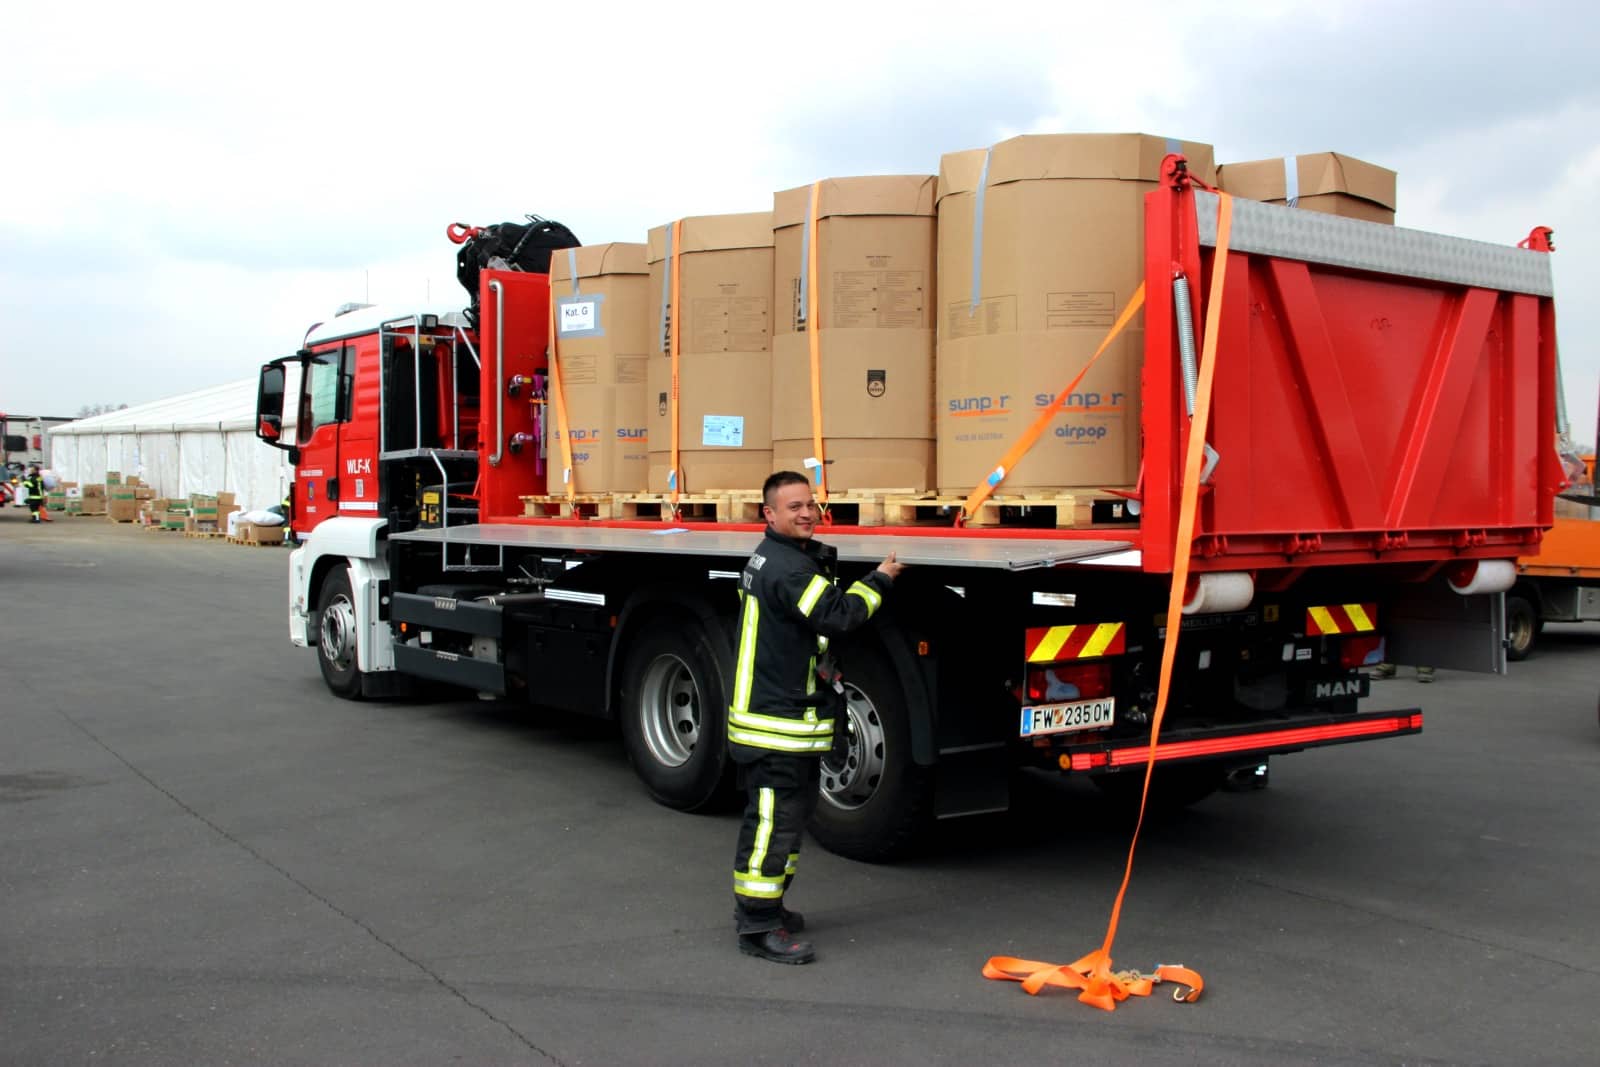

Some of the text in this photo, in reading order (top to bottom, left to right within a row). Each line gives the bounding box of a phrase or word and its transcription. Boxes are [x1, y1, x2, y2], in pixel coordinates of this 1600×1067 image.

[581, 306, 589, 316] G
[1055, 424, 1107, 440] airpop
[346, 458, 371, 475] WLF-K
[1316, 680, 1360, 698] MAN
[1033, 709, 1054, 729] FW
